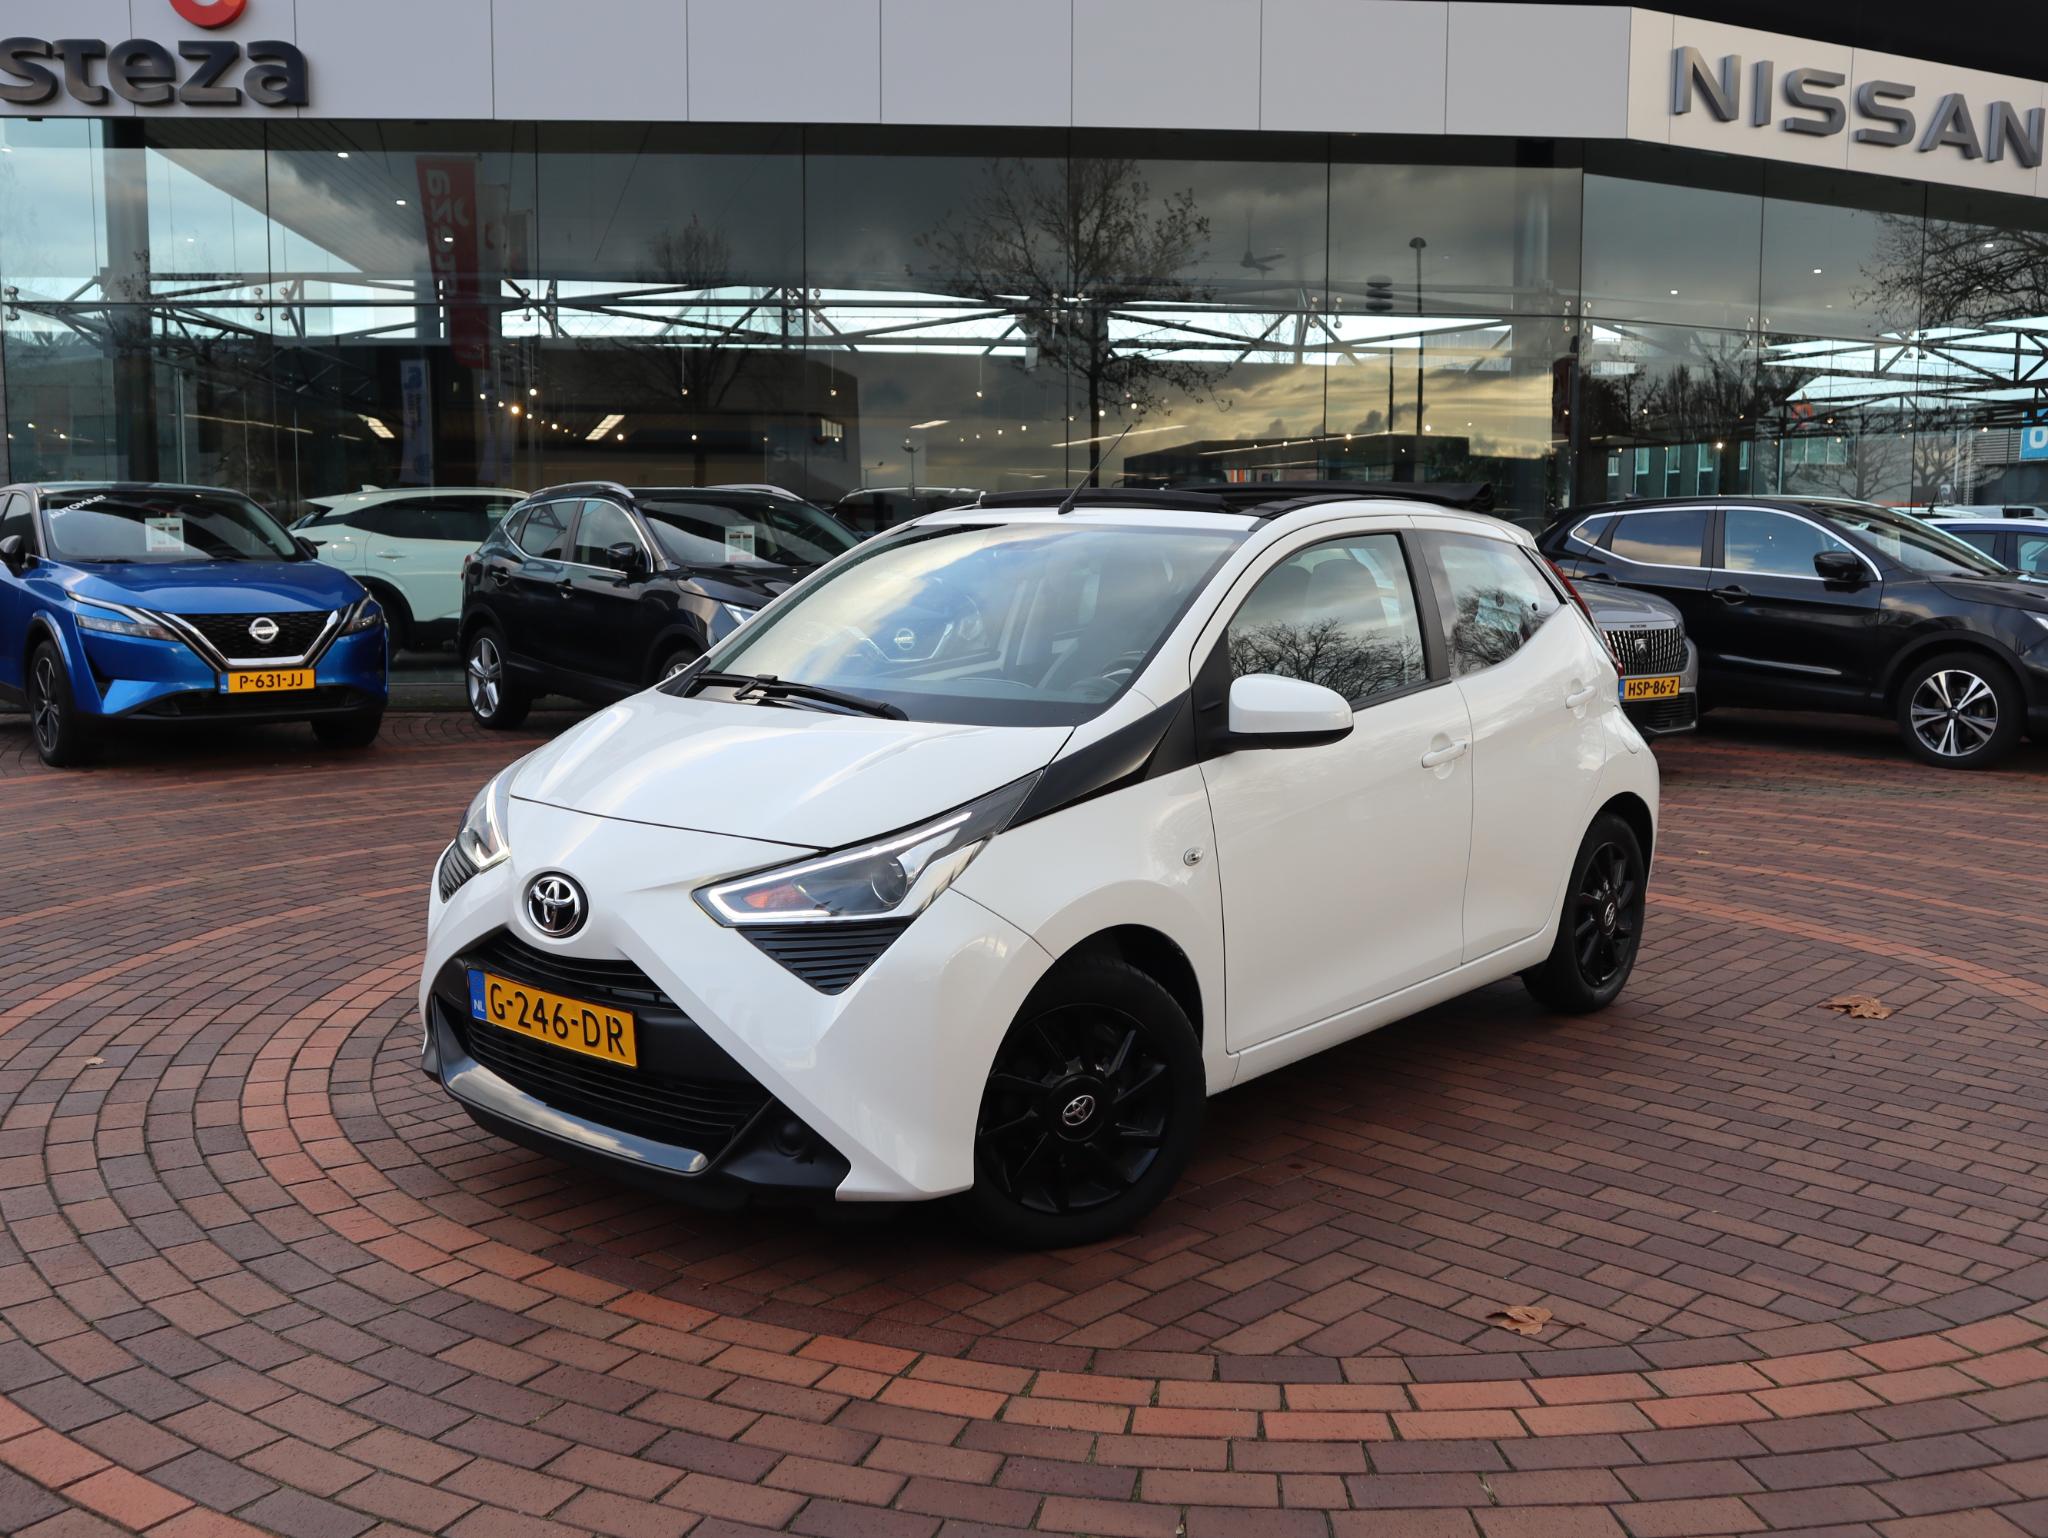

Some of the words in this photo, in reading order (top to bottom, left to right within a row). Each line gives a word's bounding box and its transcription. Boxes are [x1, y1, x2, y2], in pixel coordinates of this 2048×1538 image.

[0, 37, 309, 107] steza
[1672, 46, 2046, 168] NISSAN
[239, 673, 303, 689] P-631-JJ
[1628, 680, 1676, 696] HSP-86-Z
[473, 999, 485, 1012] NL
[490, 983, 626, 1057] G-246-DR
